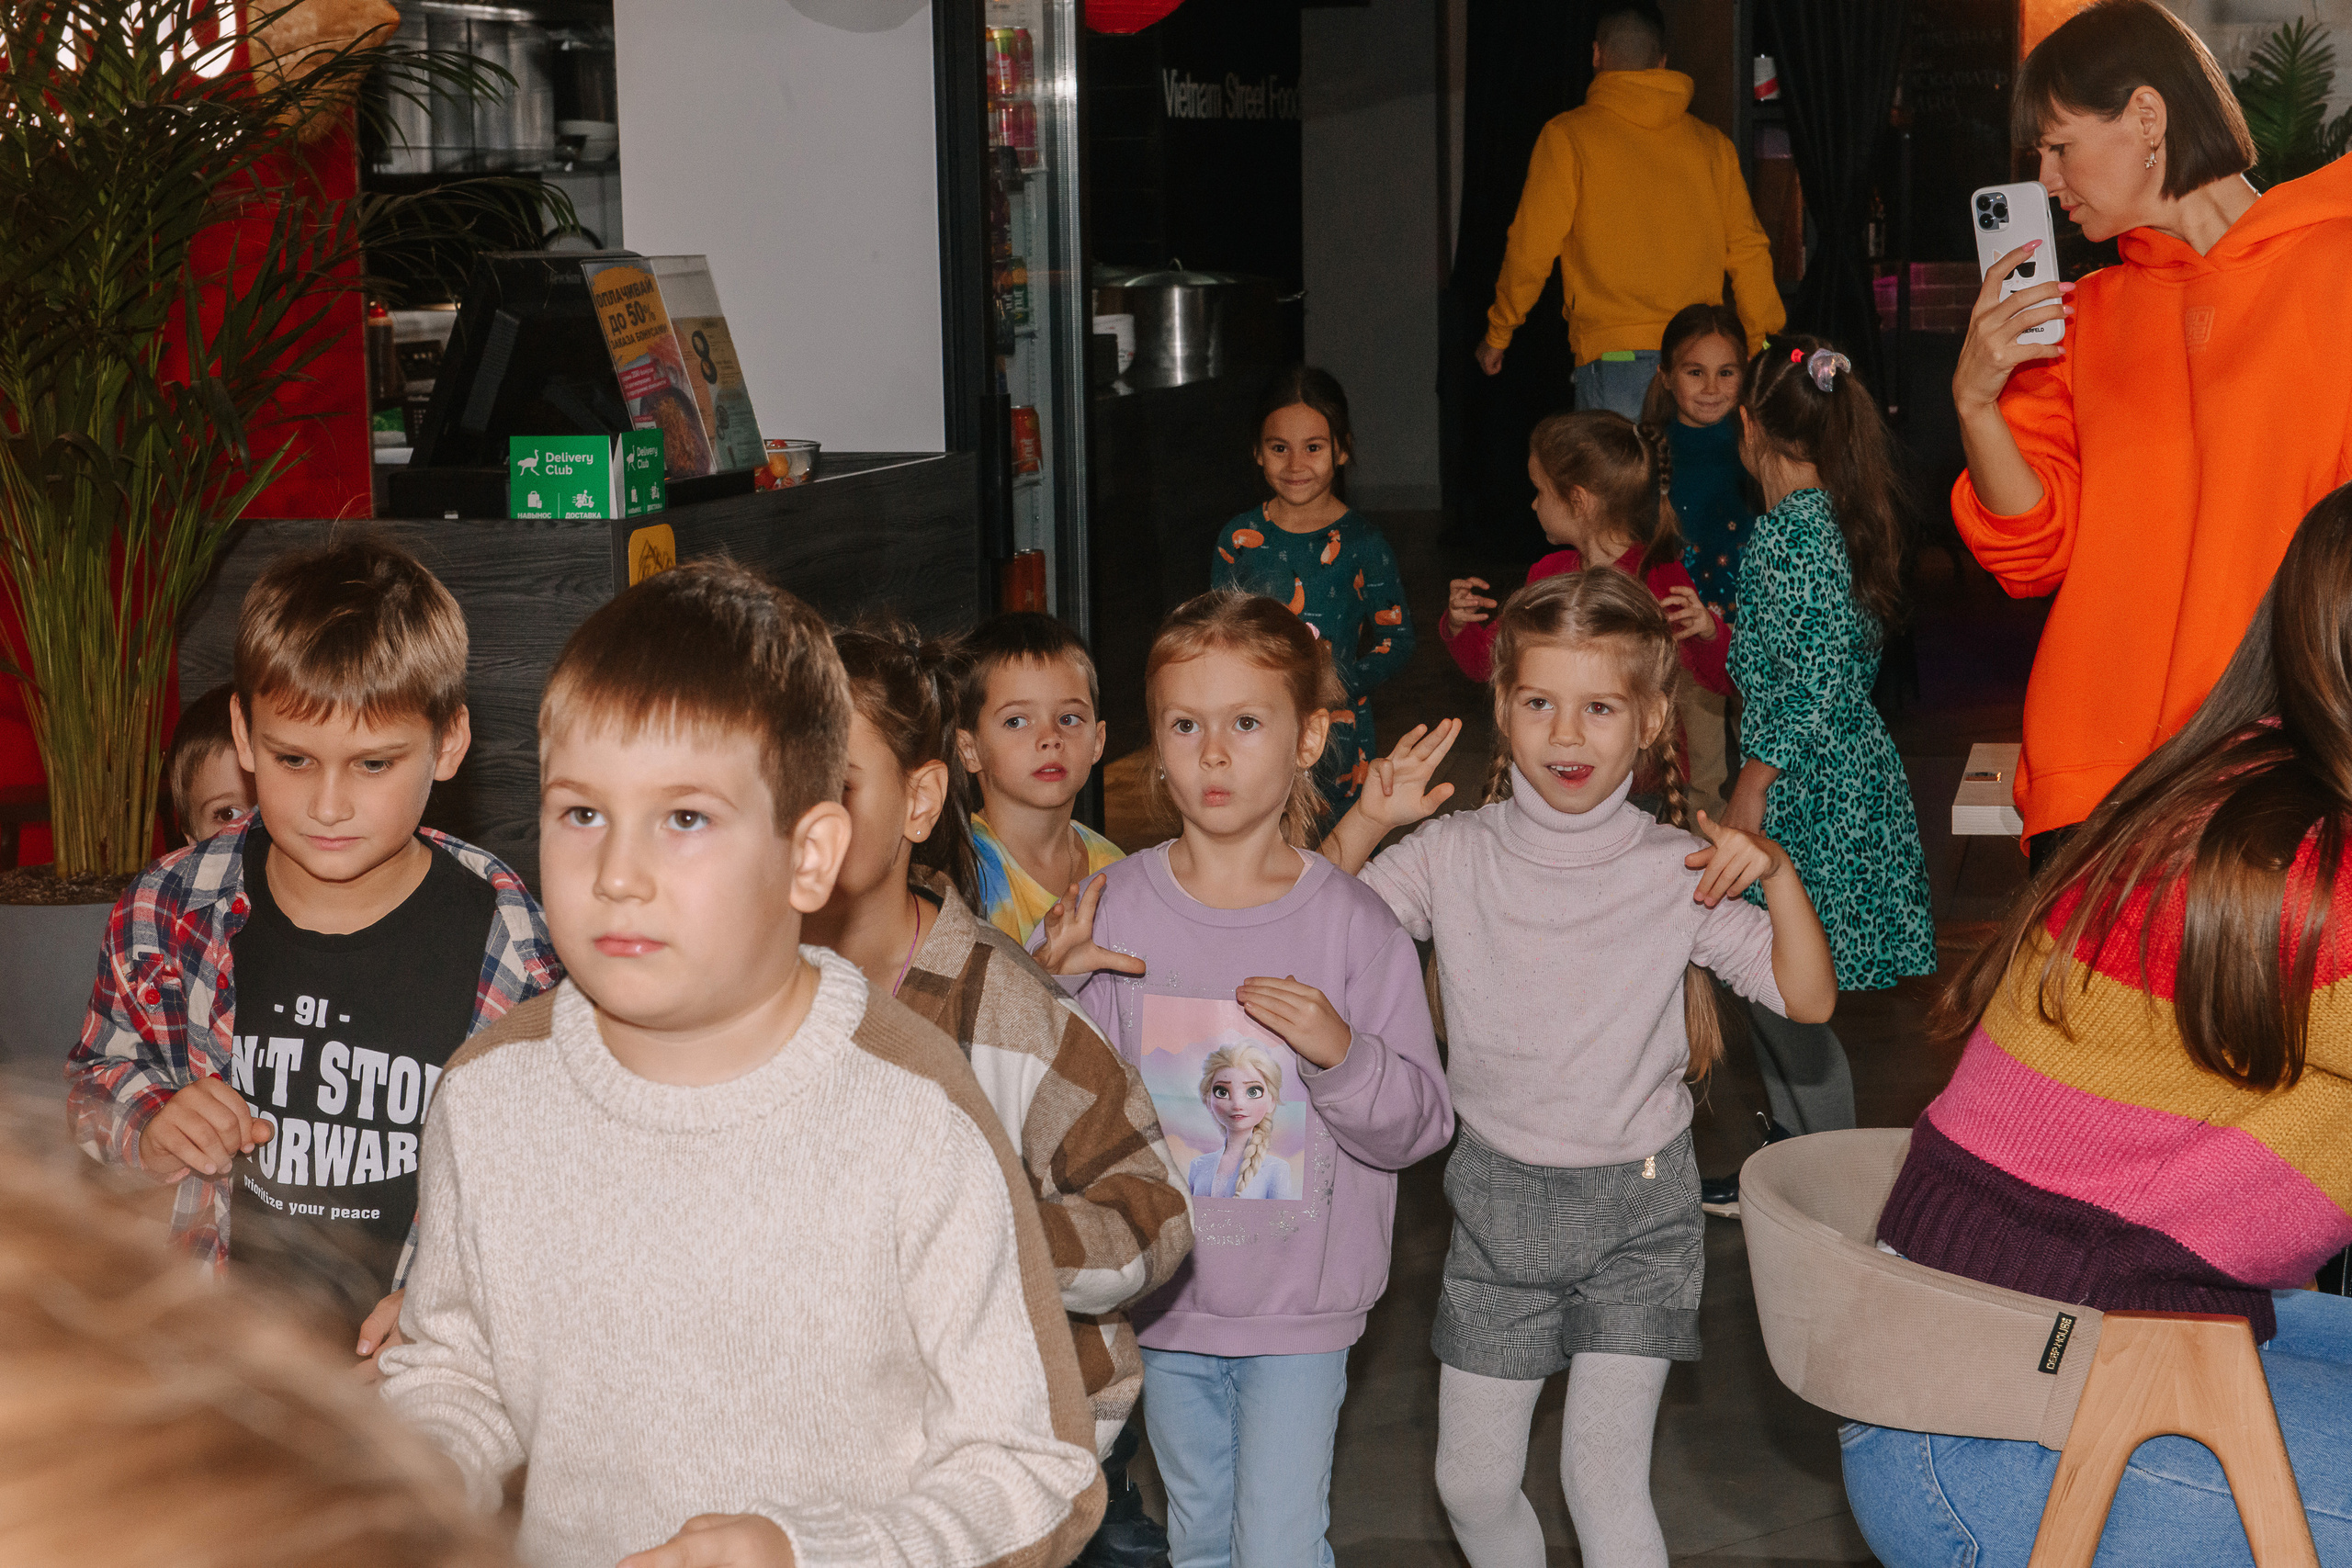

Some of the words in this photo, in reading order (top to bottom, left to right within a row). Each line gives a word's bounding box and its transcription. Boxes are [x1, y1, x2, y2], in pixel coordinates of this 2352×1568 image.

[1162, 67, 1223, 119] Vietnam
[1225, 71, 1267, 120] Street
[594, 276, 654, 308] ОПЛАЧИВАЙ
[626, 300, 656, 326] 50%
[610, 334, 637, 350] ЗАКАЗА
[635, 323, 668, 342] БОНУСАМИ
[545, 452, 594, 465] Delivery
[637, 446, 659, 457] Delivery
[545, 465, 573, 476] Club
[637, 458, 650, 469] Club
[565, 512, 602, 520] ДОСТАВКА
[243, 1174, 284, 1211] prioritize
[288, 1201, 325, 1216] your
[331, 1205, 380, 1221] peace
